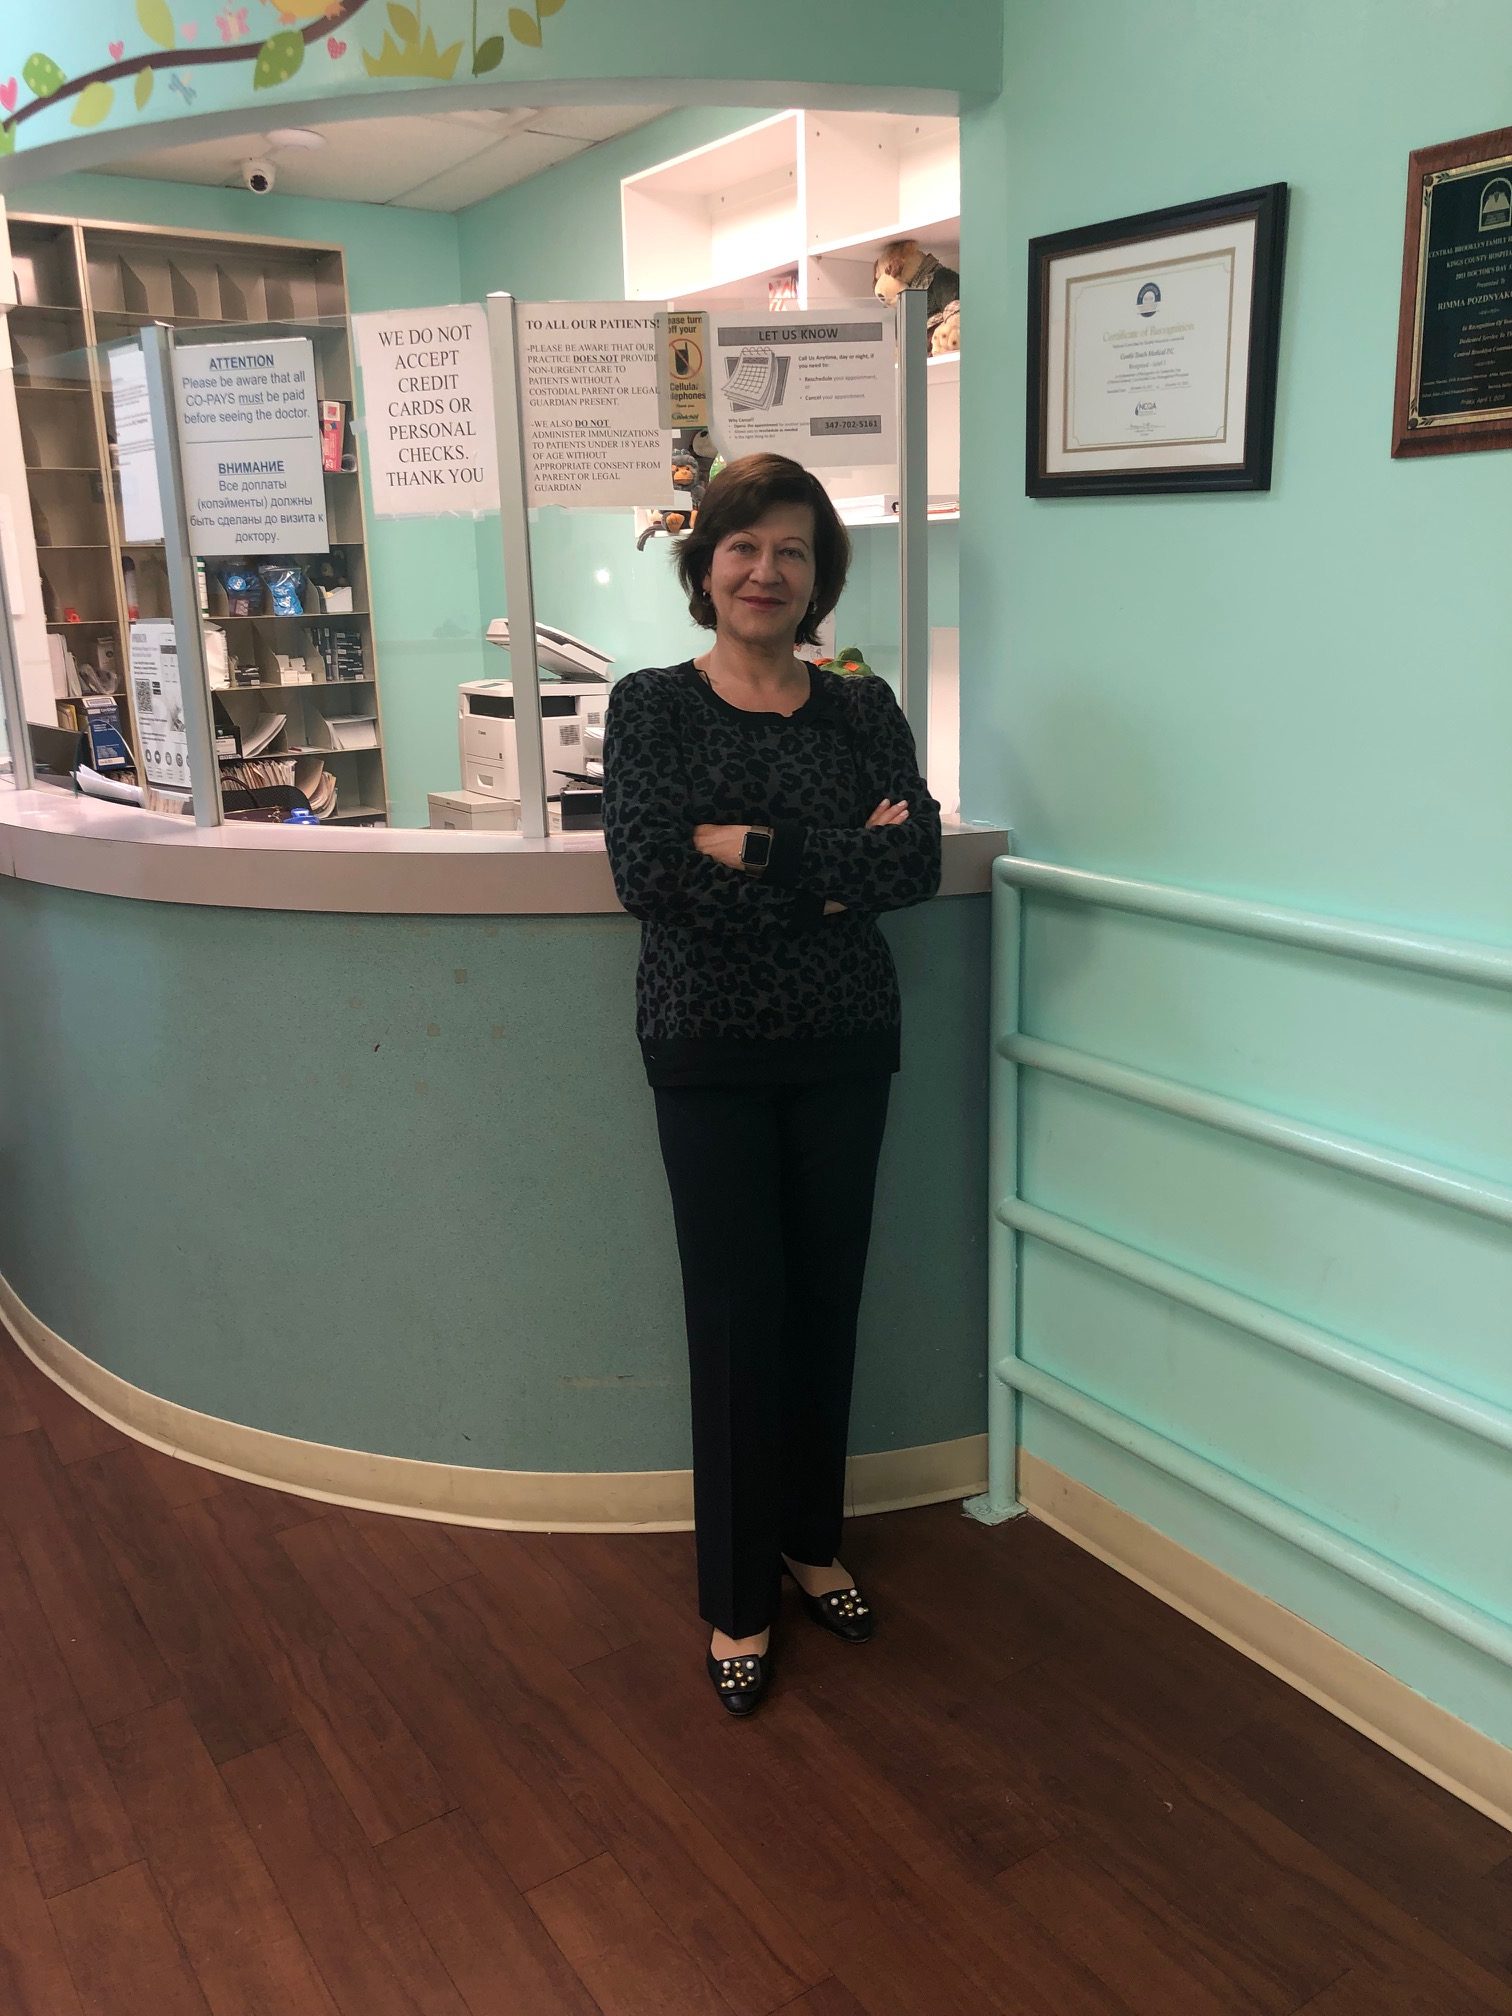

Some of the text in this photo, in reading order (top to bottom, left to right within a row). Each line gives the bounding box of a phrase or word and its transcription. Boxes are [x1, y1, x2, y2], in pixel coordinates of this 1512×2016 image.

[1438, 299, 1465, 310] RIMMA
[526, 319, 660, 330] TO ALL OUR PATIENTS!
[379, 325, 472, 347] WE DO NOT
[680, 326, 696, 335] your
[759, 328, 838, 341] LET US KNOW
[565, 344, 576, 352] BE
[612, 343, 633, 351] THAT
[635, 343, 654, 351] OUR
[210, 355, 274, 369] ATTENTION
[395, 350, 459, 369] ACCEPT
[528, 354, 658, 363] PRACTICE DOES NOT PROVIDE
[529, 366, 586, 374] NON-URGENT
[615, 365, 626, 373] TO
[183, 371, 305, 389] Please be aware that all
[399, 374, 458, 392] CREDIT
[529, 376, 569, 384] PATIENTS
[571, 376, 612, 384] WITHOUT
[582, 387, 615, 395] PARENT
[617, 386, 629, 395] OR
[631, 386, 661, 394] LEGAL
[186, 389, 305, 407] CO-PAYS must be paid
[530, 398, 577, 406] GUARDIAN
[388, 398, 472, 417] CARDS OR
[185, 408, 310, 424] before seeing the doctor.
[575, 419, 588, 428] DO
[590, 419, 609, 427] NOT
[825, 421, 877, 429] 347-702-5161
[390, 421, 476, 440] PERSONAL
[532, 429, 659, 438] ADMINISTER IMMUNIZATIONS
[533, 440, 660, 449] TO PATIENTS UNDER 18 YEARS
[399, 445, 469, 463] CHECKS.
[533, 452, 544, 460] OF
[566, 451, 607, 459] WITHOUT
[219, 461, 284, 474] ВНИМАНИЕ
[534, 461, 661, 470] APPROPRIATE CONSENT FROM
[387, 468, 484, 487] THANK YOU
[535, 472, 620, 481] A PARENT OR LEGAL
[219, 481, 287, 492] Все доплаты
[198, 497, 312, 511] (копэйменты) должны
[191, 513, 323, 528] быть сделаны до визита к
[235, 533, 279, 543] доктору.
